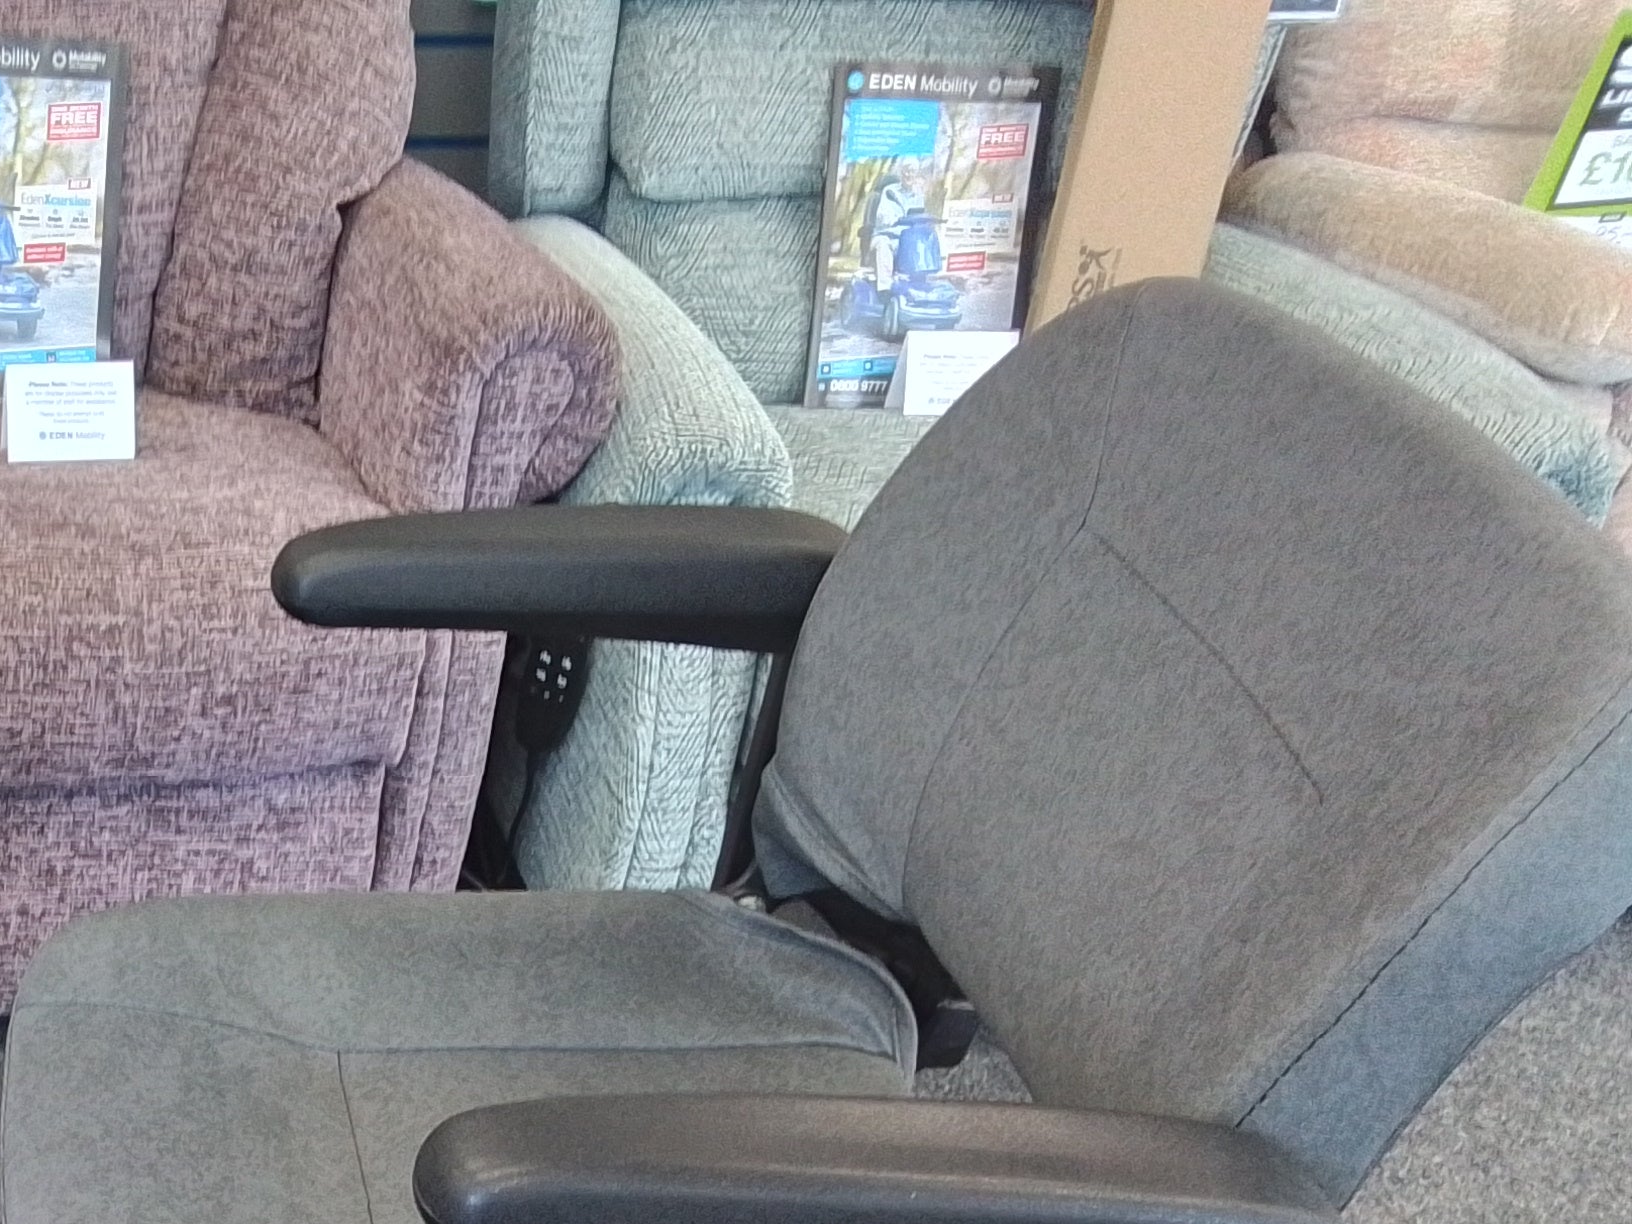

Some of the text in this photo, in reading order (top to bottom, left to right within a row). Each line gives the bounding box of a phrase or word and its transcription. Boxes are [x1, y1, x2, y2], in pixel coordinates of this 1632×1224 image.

[869, 73, 917, 91] EDEN
[920, 74, 979, 99] Mobility
[50, 111, 98, 124] FREE
[980, 131, 1025, 145] FREE
[830, 379, 888, 393] 0800 9777
[49, 431, 74, 440] EDEN
